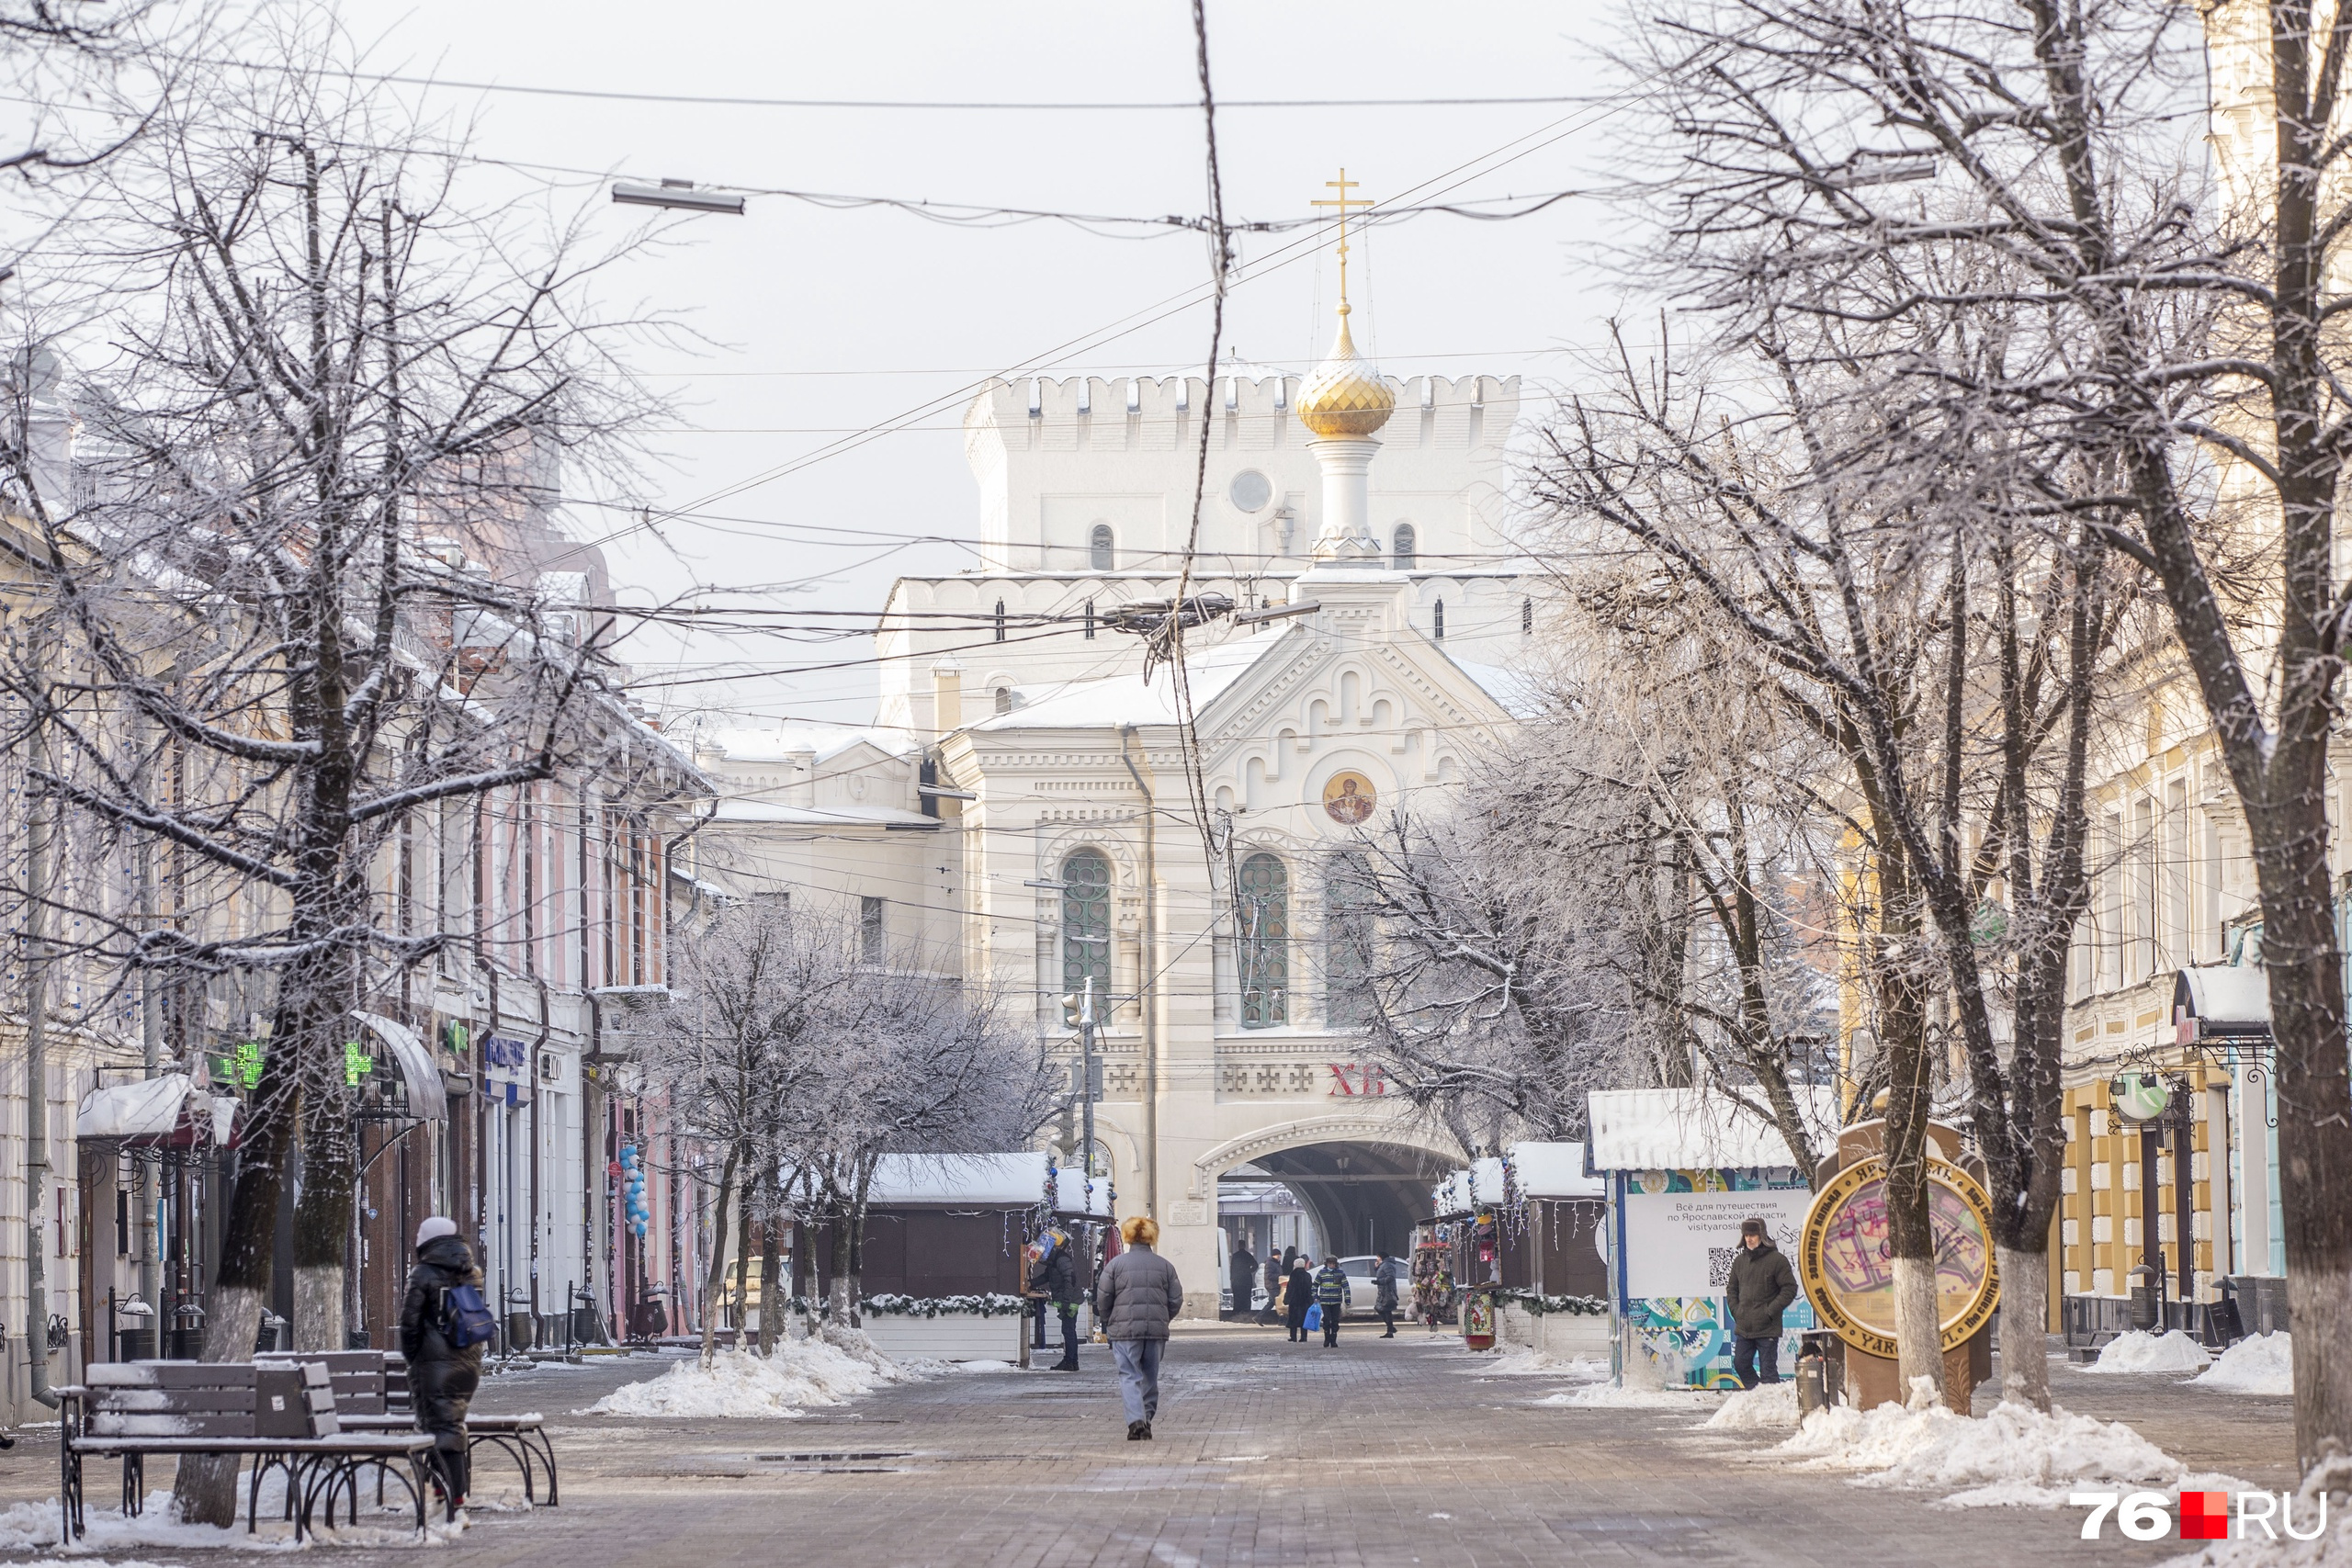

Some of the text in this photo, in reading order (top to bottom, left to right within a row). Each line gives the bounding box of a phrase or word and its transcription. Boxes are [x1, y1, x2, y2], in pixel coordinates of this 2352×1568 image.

[1676, 1201, 1778, 1213] Всё для путешествия
[1681, 1211, 1745, 1223] Ярославской
[1747, 1211, 1787, 1220] области
[1688, 1222, 1743, 1233] visityarosla
[1807, 1229, 1820, 1280] золотого
[1814, 1189, 1842, 1227] кольца
[1977, 1278, 2000, 1316] capital
[1861, 1331, 1959, 1355] YARVL
